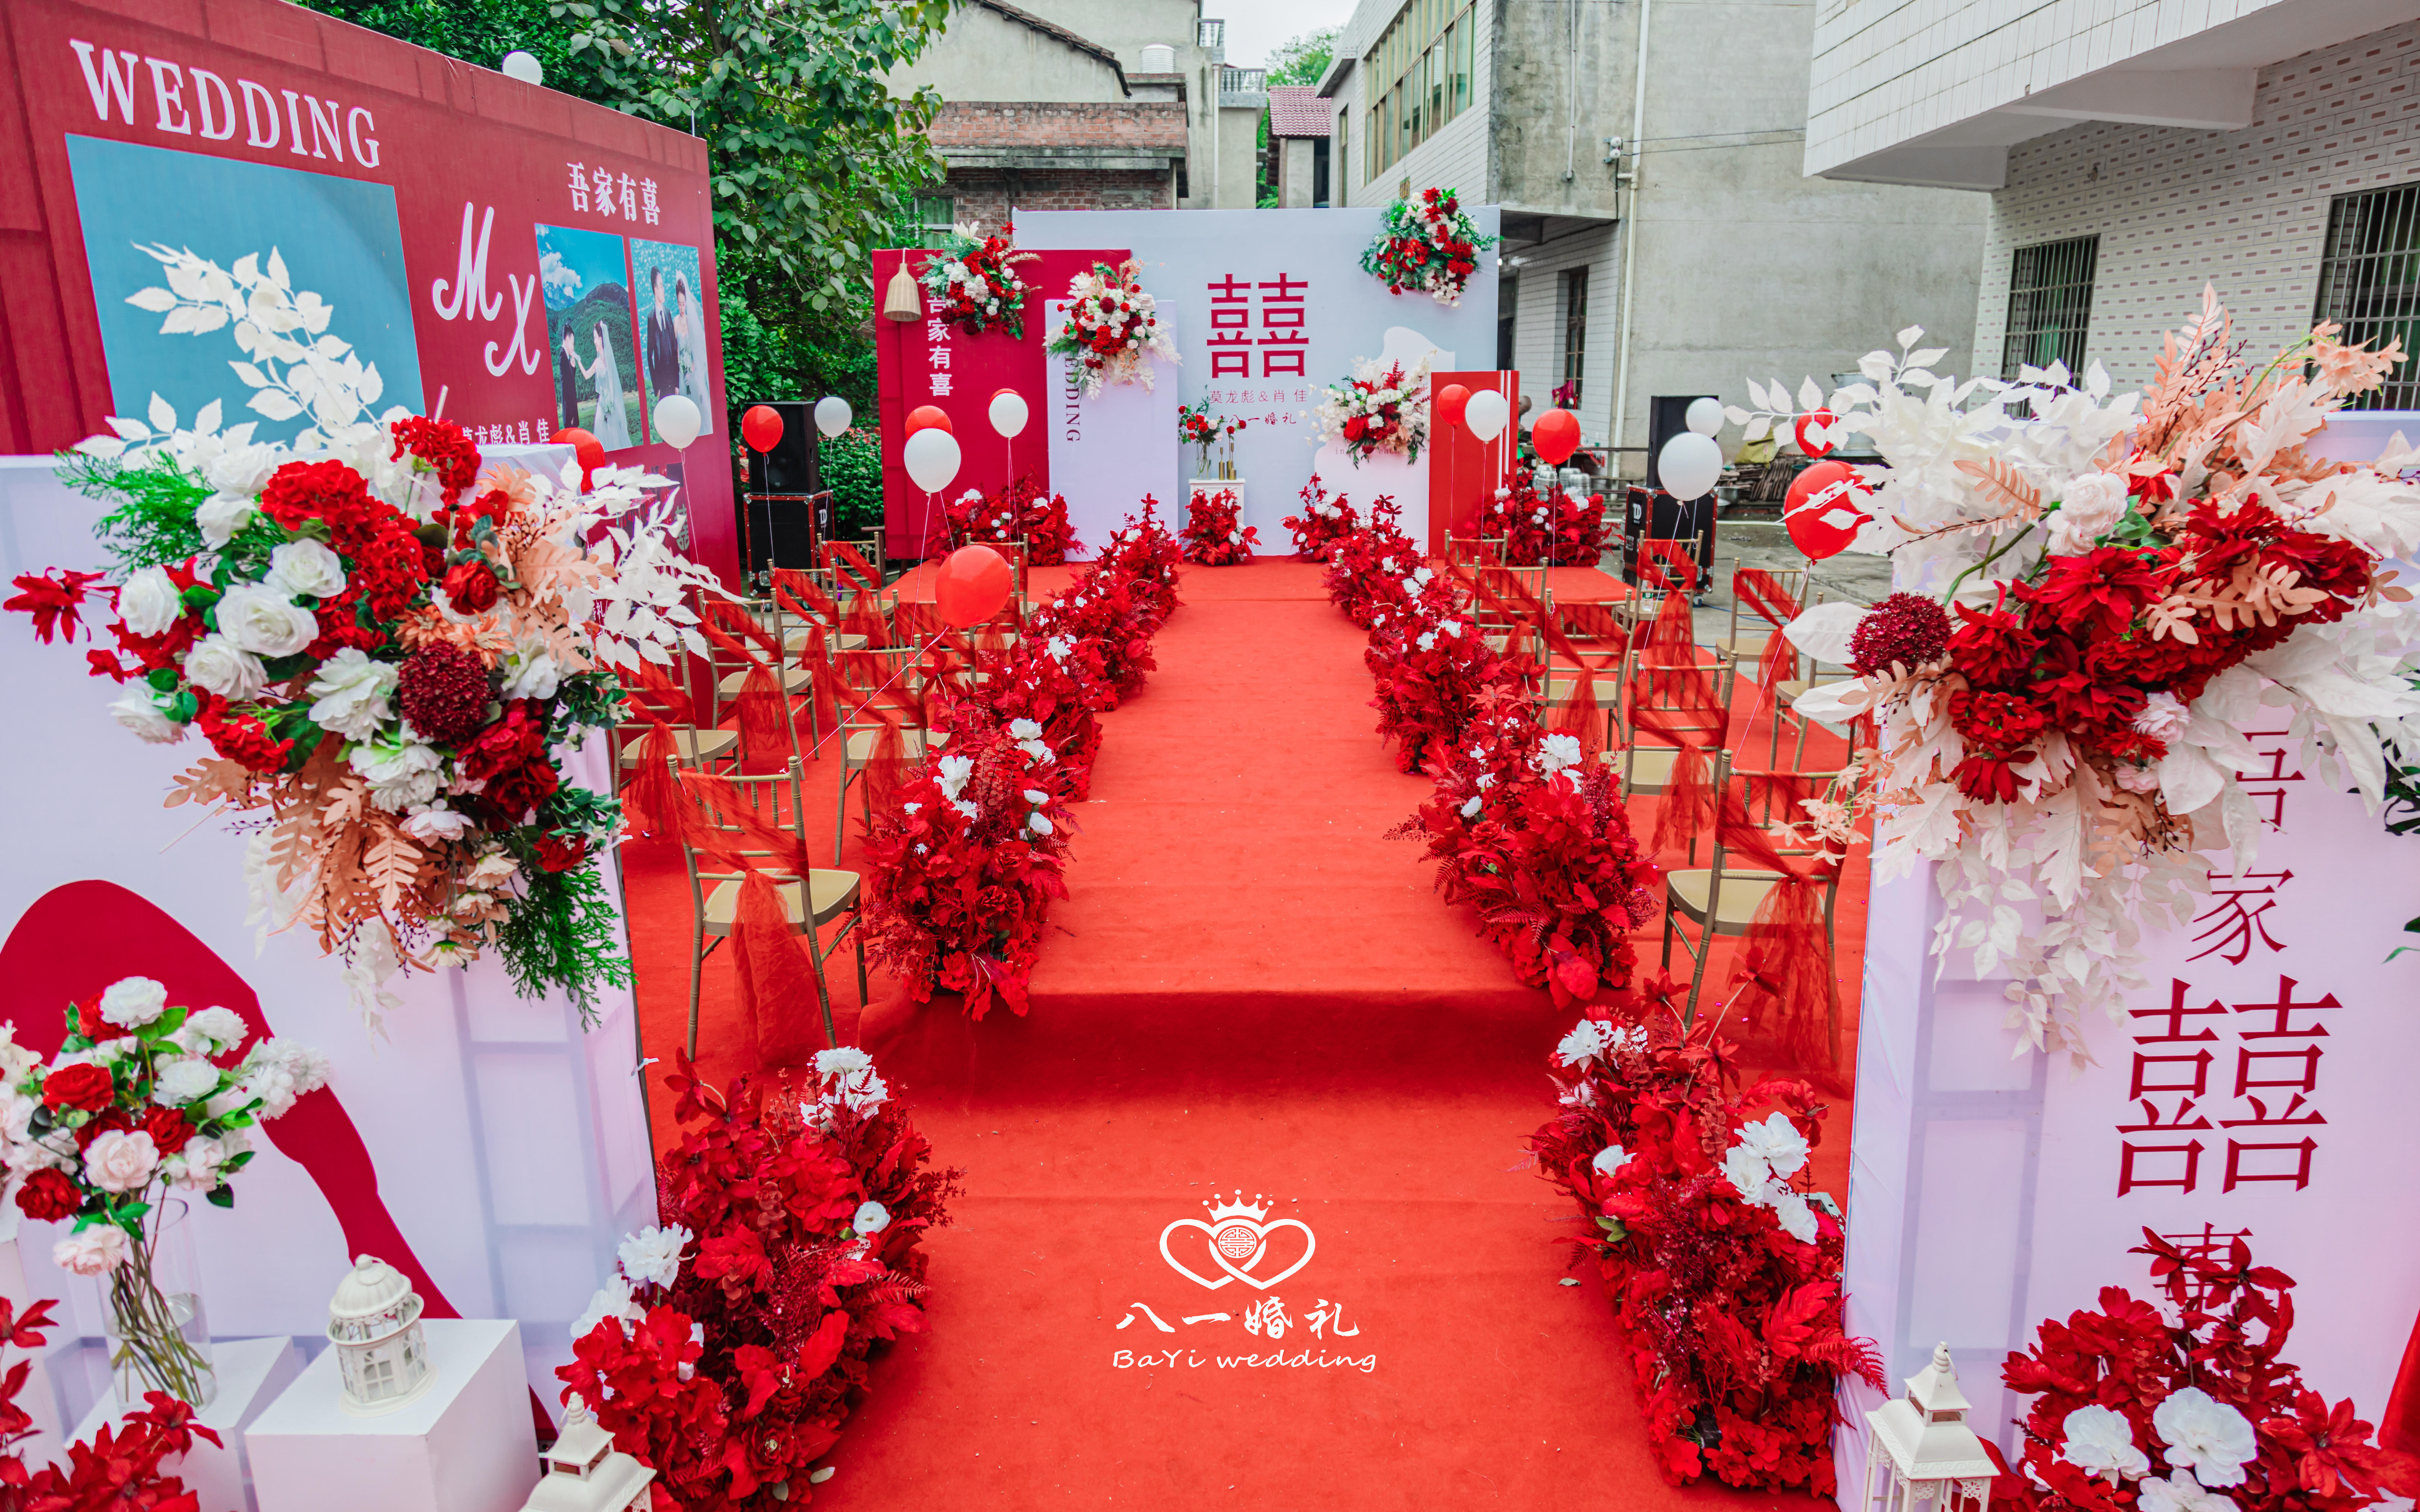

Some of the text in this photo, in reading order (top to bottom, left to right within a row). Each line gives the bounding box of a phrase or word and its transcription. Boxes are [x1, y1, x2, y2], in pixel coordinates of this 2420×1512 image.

[70, 39, 380, 168] WEDDING
[566, 162, 660, 226] 吾家有喜
[432, 202, 540, 377] M X
[1207, 273, 1309, 379] 囍
[1065, 357, 1081, 442] EDDING
[1229, 411, 1296, 425] 八一婚礼
